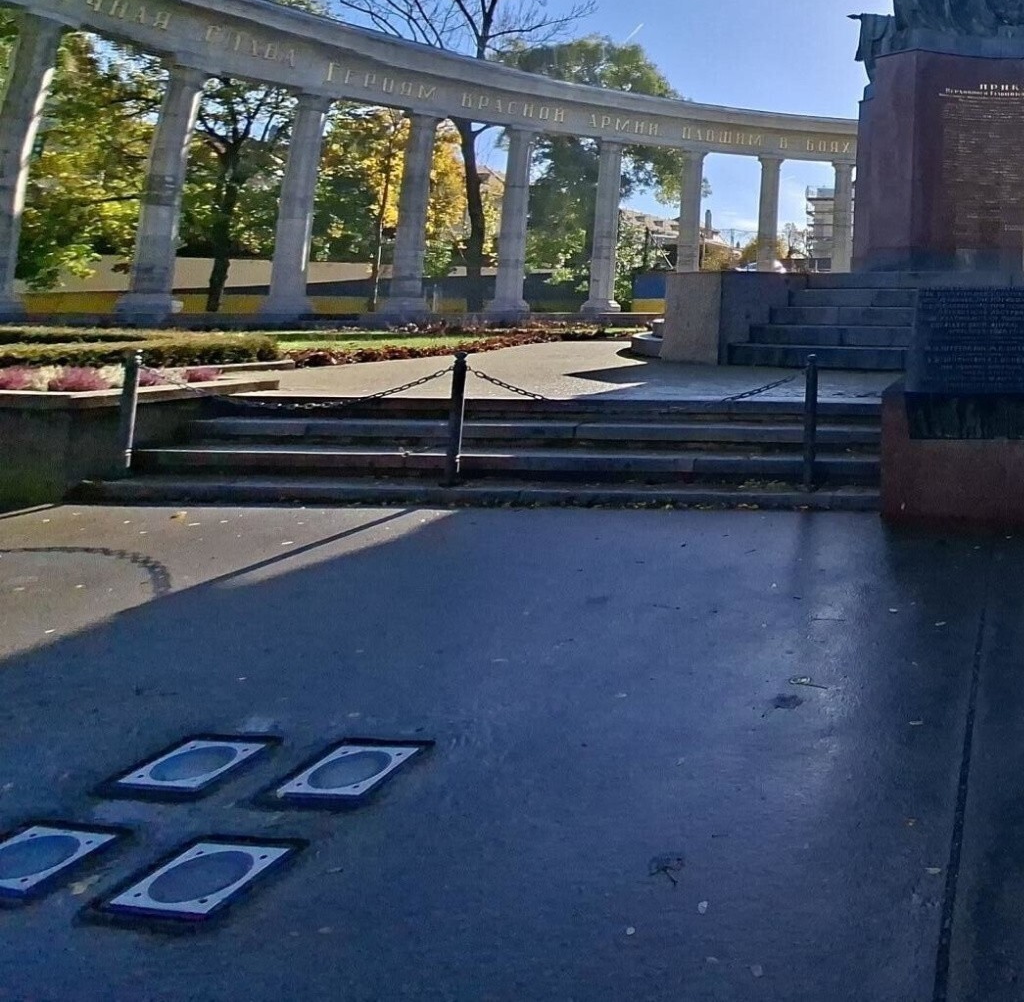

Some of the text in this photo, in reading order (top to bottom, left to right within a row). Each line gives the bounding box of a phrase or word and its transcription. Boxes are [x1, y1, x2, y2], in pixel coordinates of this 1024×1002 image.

[326, 61, 440, 100] ГЕРОЯМ
[461, 92, 565, 123] КРАСНОЙ
[682, 126, 762, 147] ПАВШИМ
[779, 136, 788, 149] В
[806, 139, 850, 153] БОЯХ
